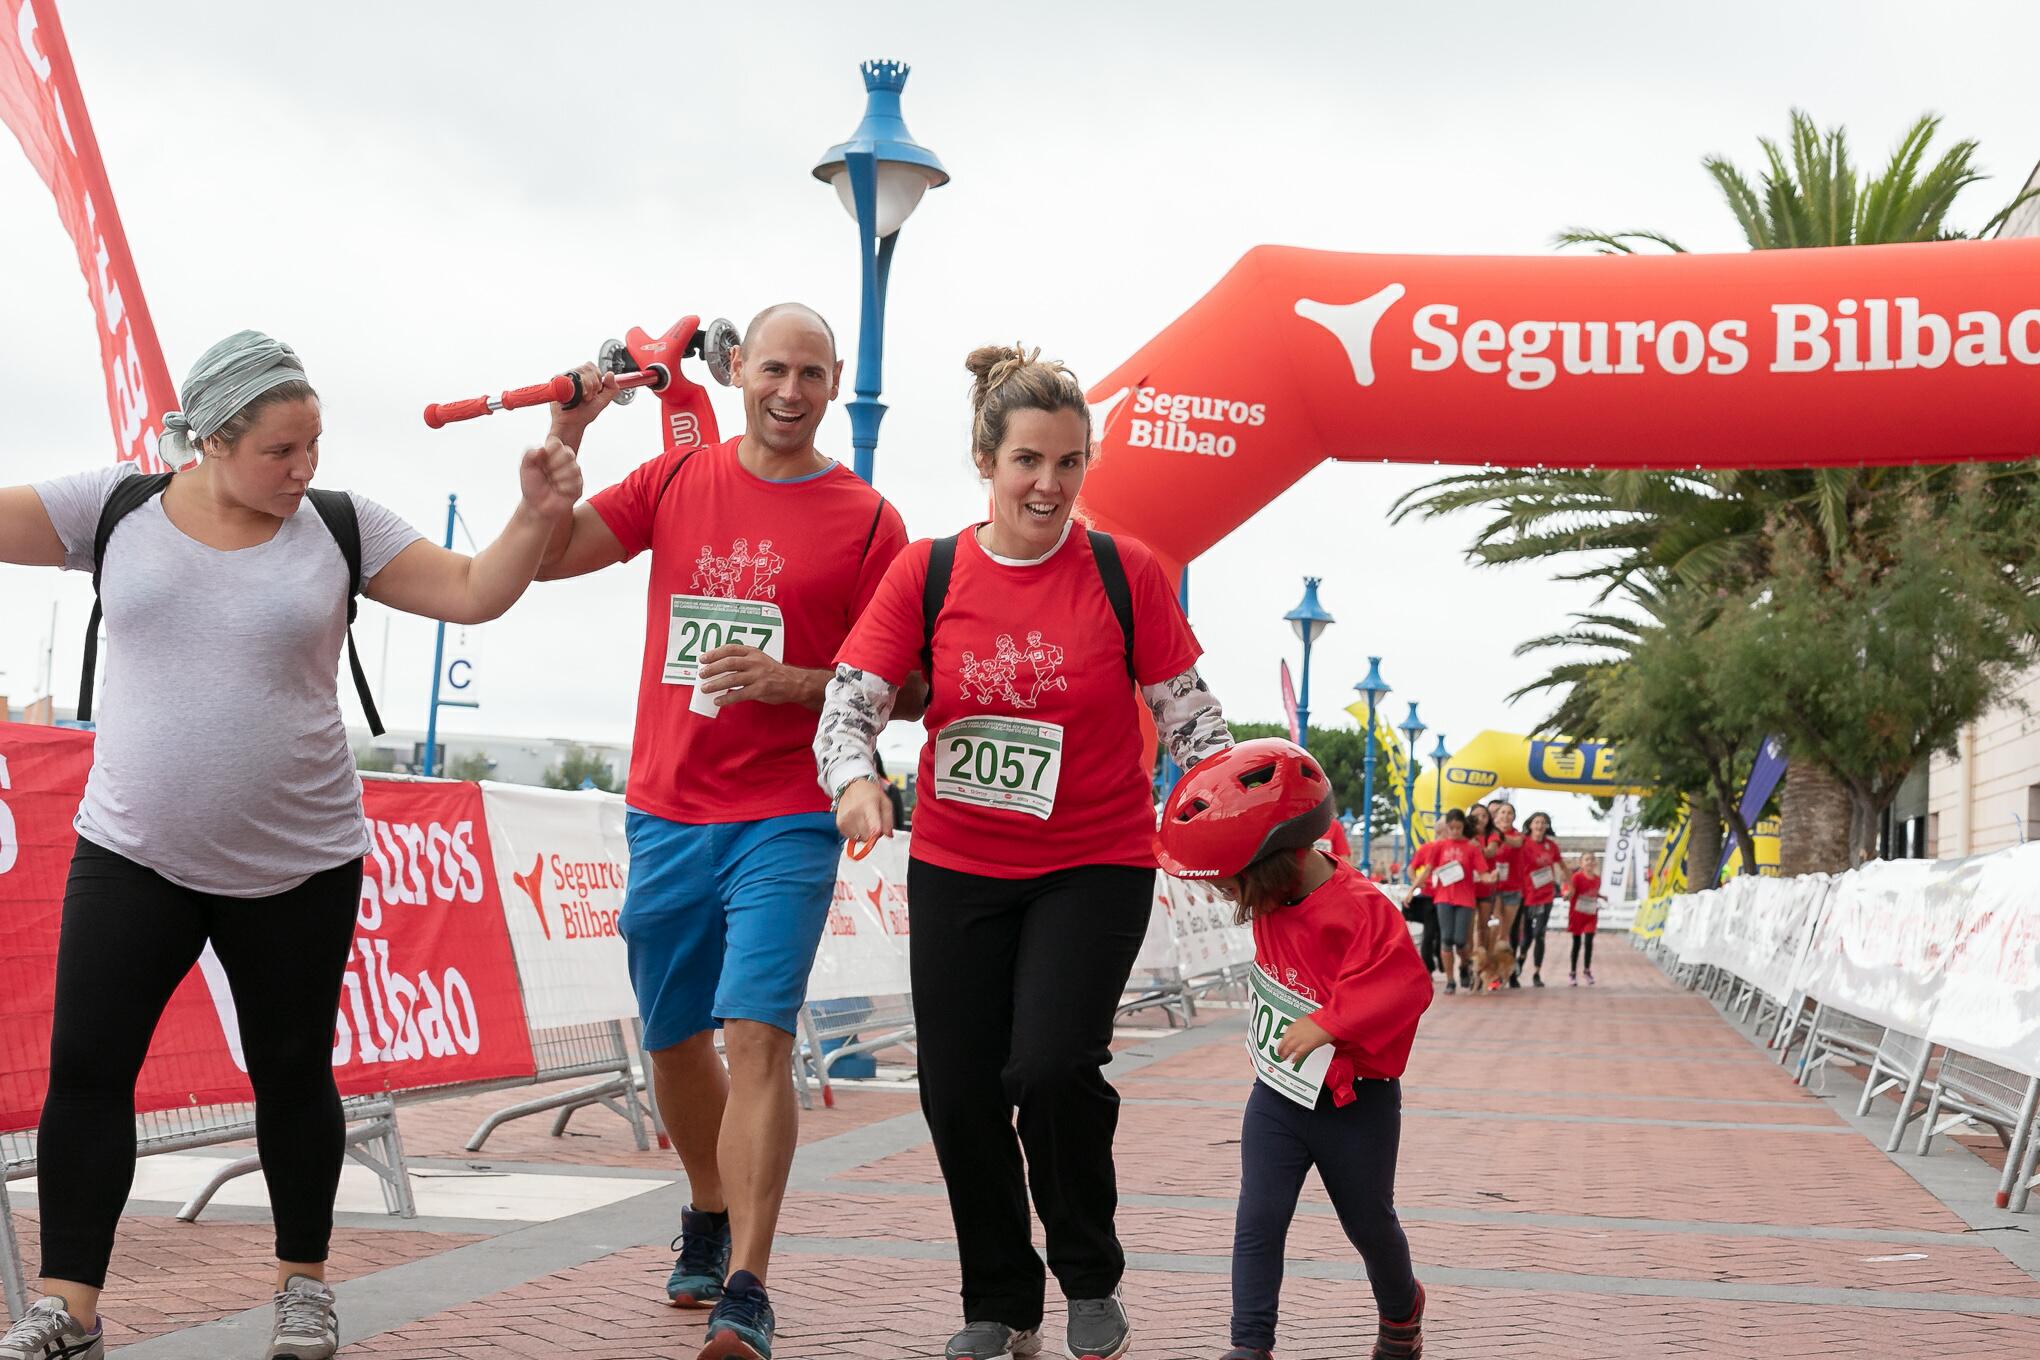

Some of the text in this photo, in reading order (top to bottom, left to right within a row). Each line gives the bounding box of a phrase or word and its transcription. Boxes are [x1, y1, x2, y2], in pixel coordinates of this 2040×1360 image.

[1411, 297, 2040, 390] Seguros Bilbao
[1133, 387, 1266, 426] Seguros
[1127, 419, 1236, 458] Bilbao
[448, 660, 472, 689] C
[949, 738, 1051, 791] 2057
[356, 820, 484, 930] uros
